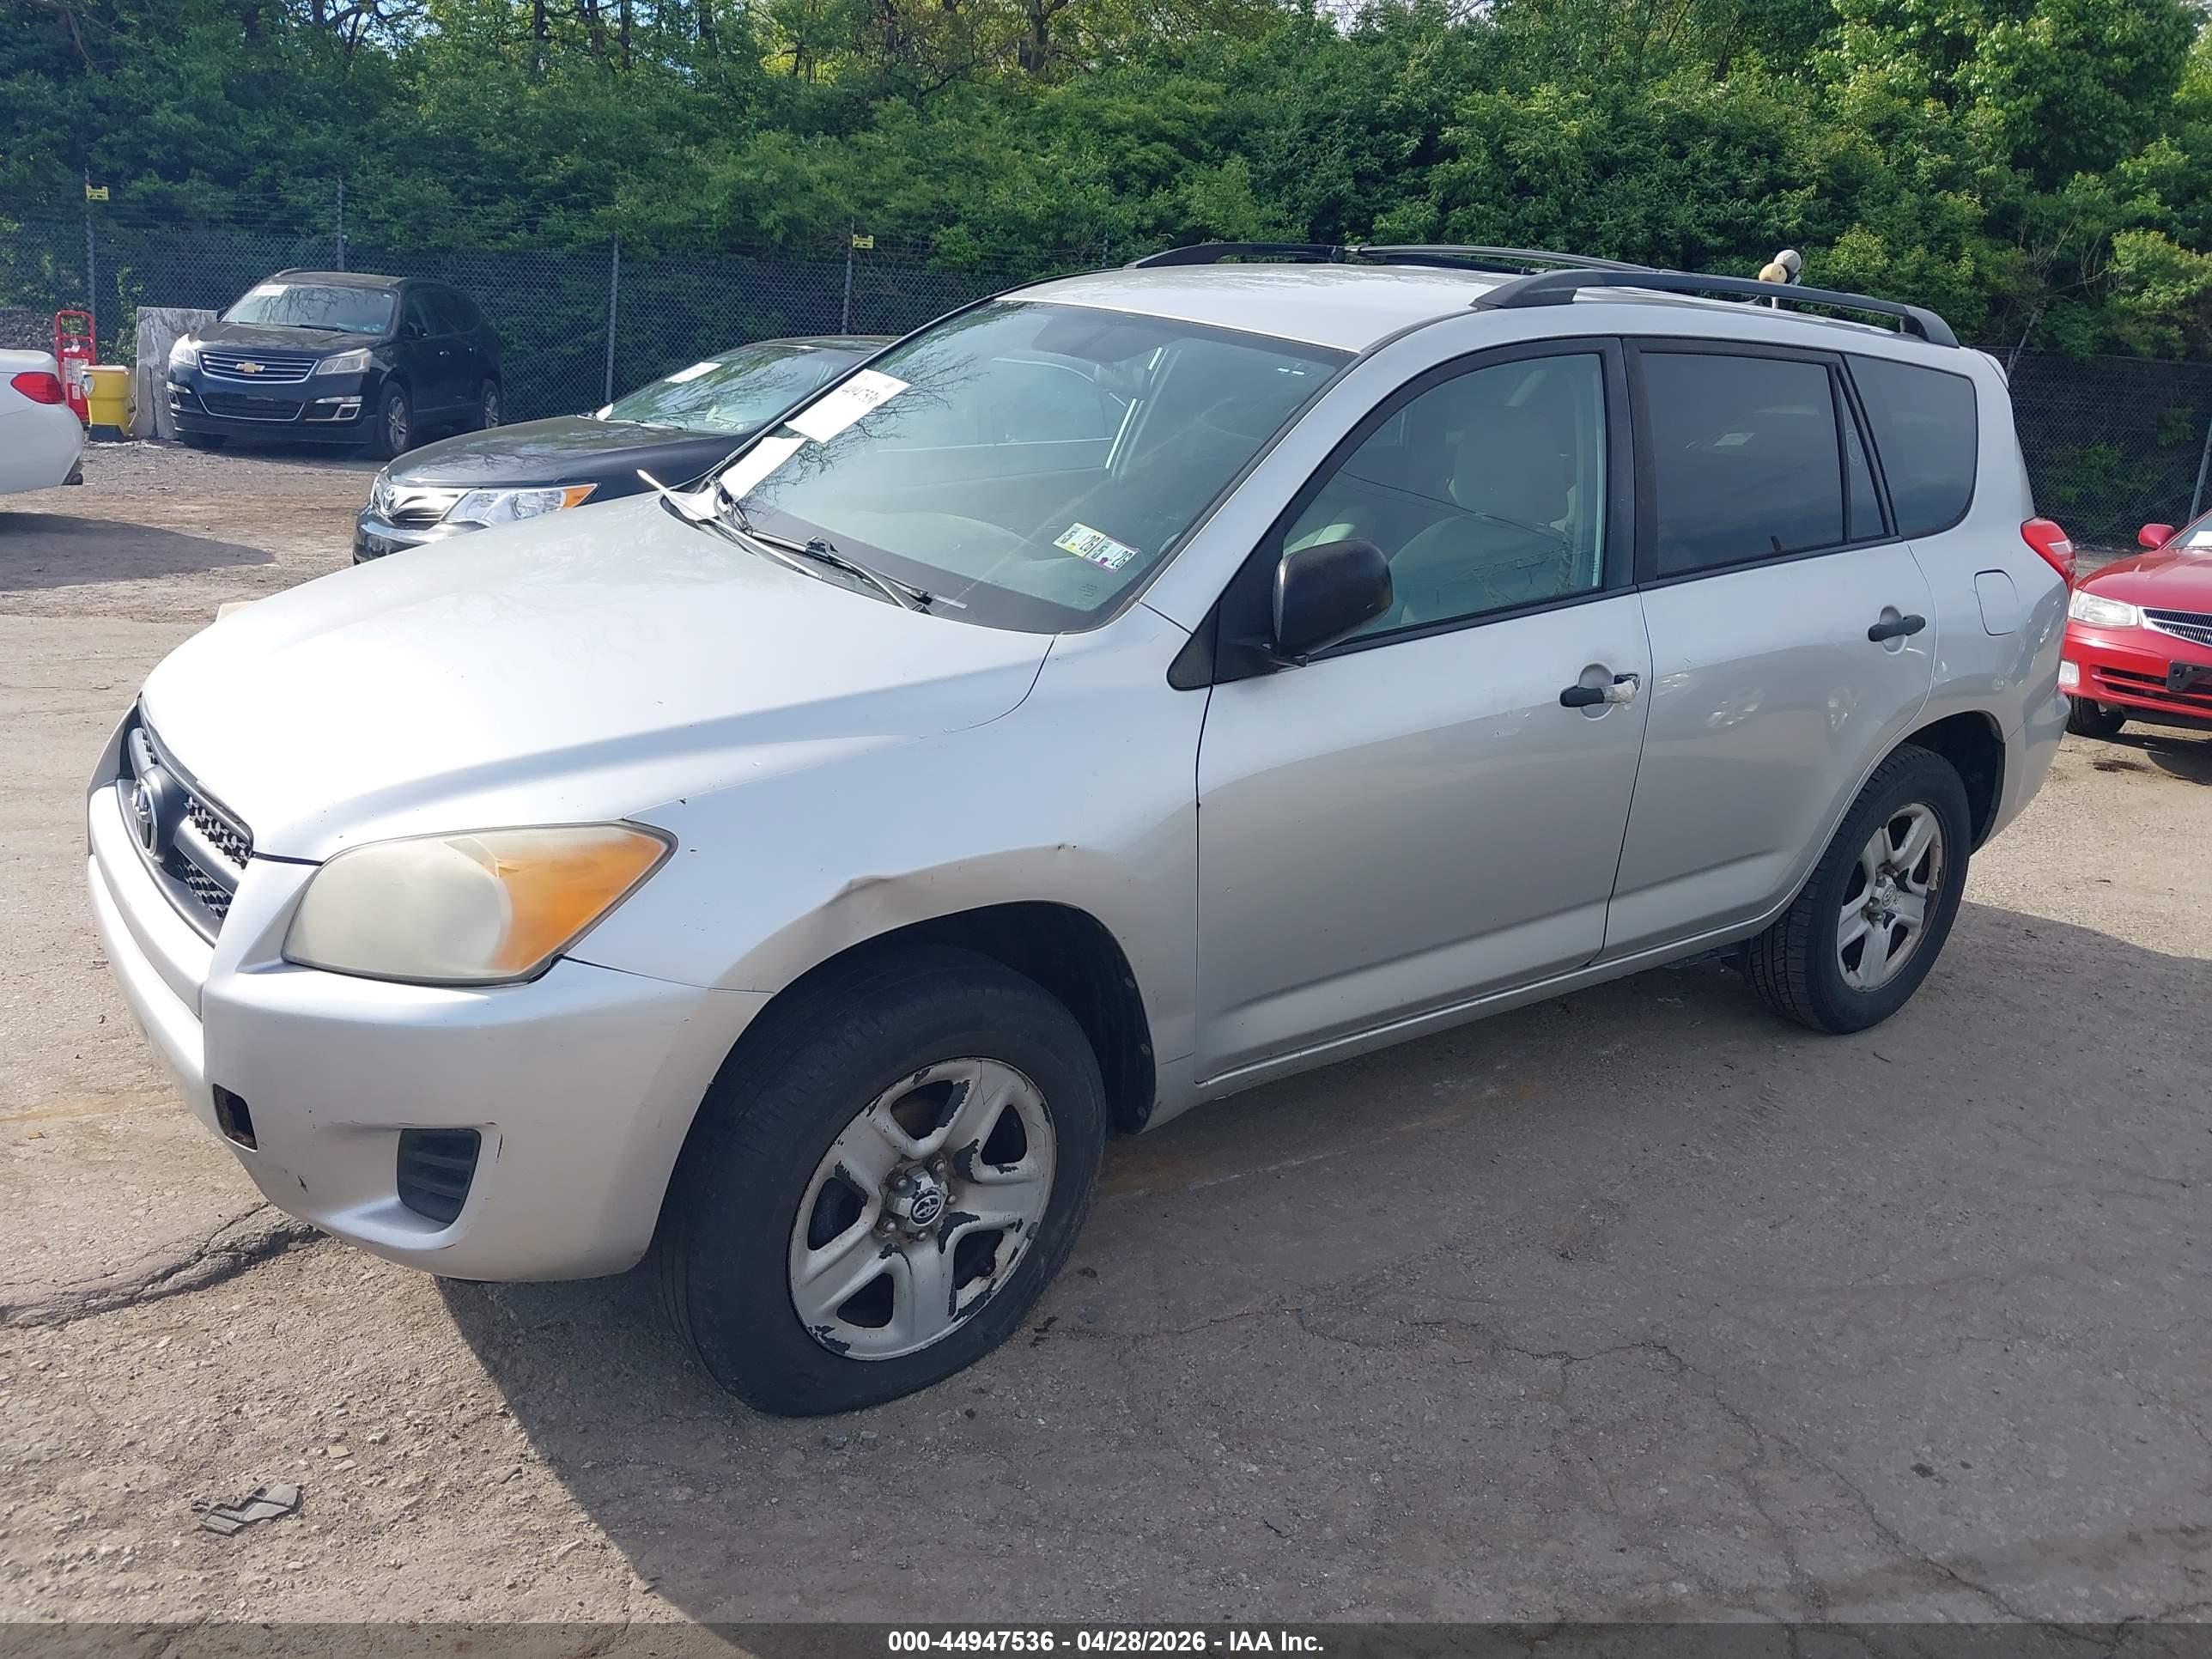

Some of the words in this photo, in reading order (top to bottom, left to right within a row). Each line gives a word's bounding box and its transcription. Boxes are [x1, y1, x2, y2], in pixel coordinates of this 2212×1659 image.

[1079, 535, 1100, 551] 26
[1091, 545, 1109, 559] 5
[1111, 550, 1133, 568] 26
